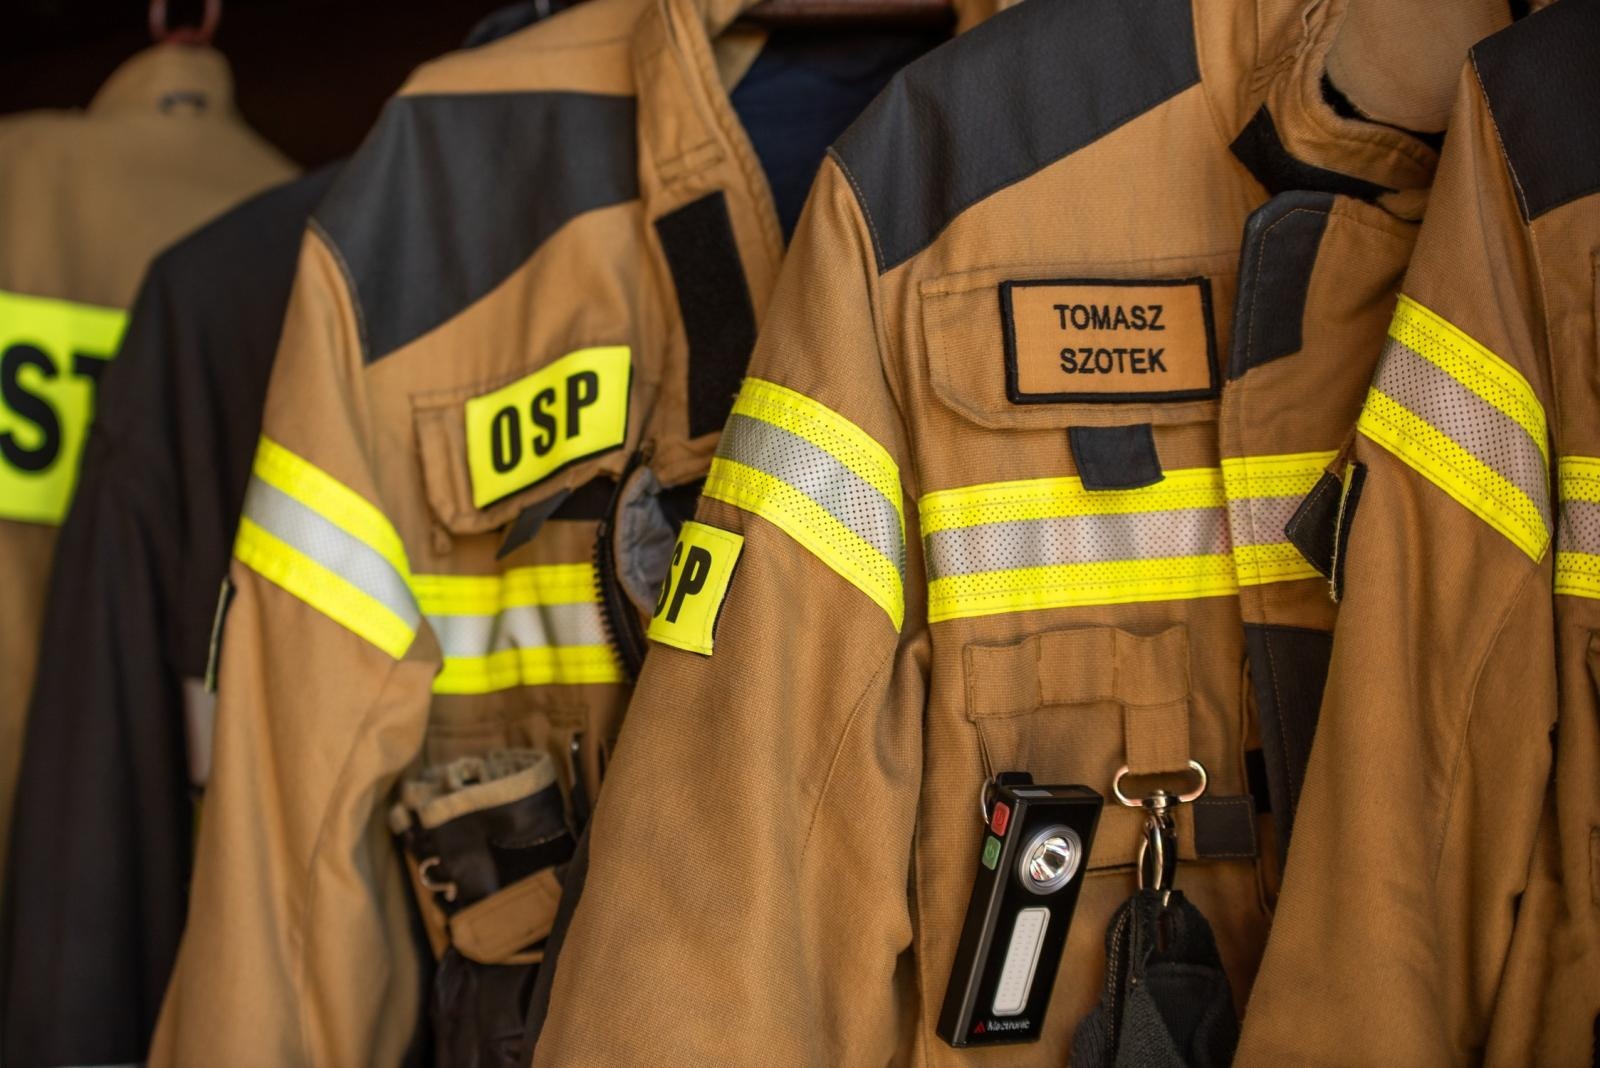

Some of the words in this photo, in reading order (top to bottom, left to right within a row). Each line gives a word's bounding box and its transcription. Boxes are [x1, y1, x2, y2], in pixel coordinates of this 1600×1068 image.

[1053, 304, 1166, 330] TOMASZ
[1060, 347, 1168, 374] SZOTEK
[490, 370, 600, 474] OSP
